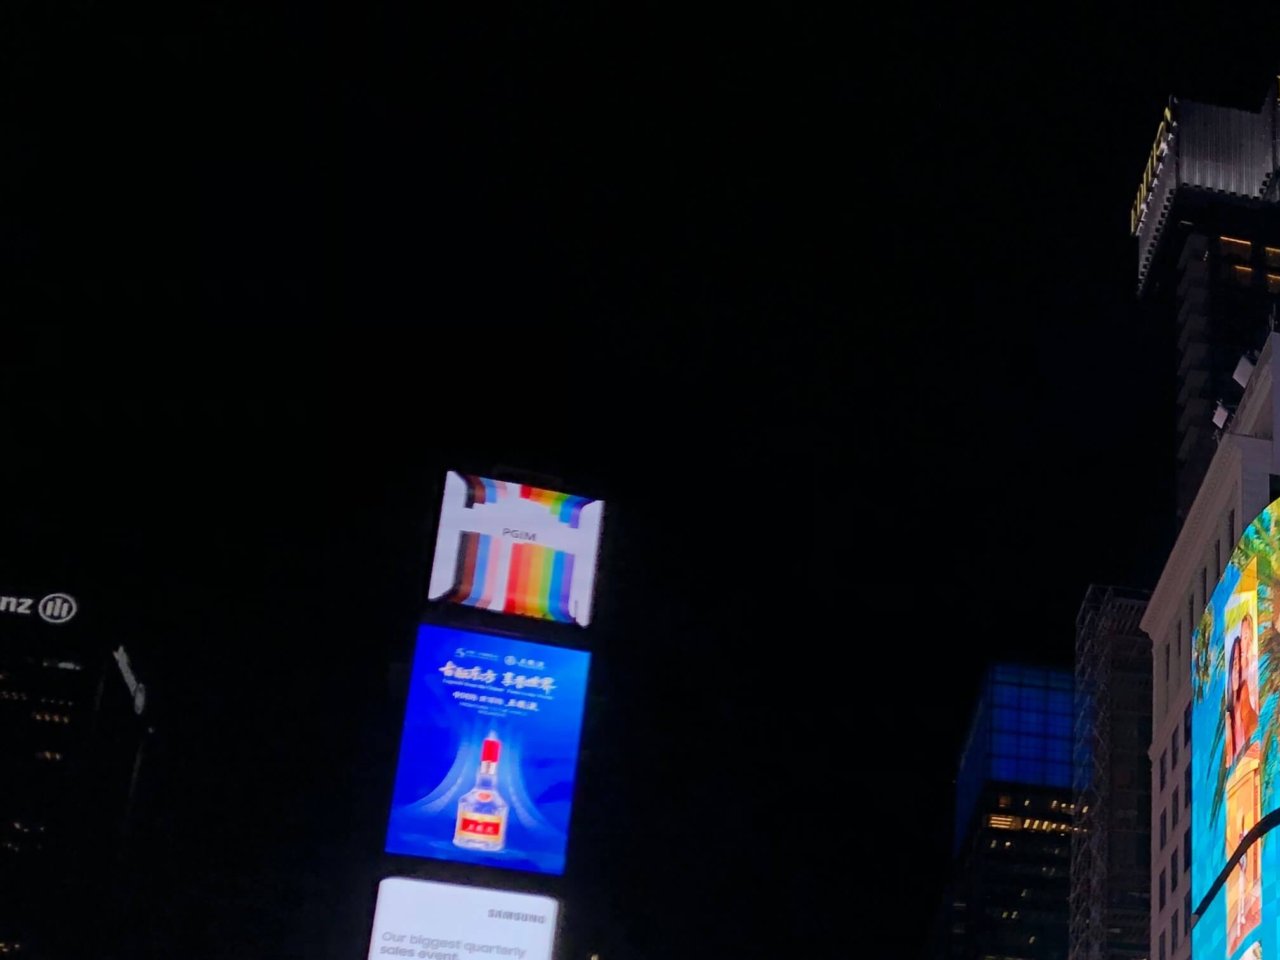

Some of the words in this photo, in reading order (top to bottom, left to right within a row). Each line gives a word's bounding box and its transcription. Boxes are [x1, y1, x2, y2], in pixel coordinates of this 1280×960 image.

[487, 909, 546, 924] SAMSUNG
[379, 945, 415, 957] sales
[381, 931, 407, 943] Our
[409, 934, 462, 950] biggest
[464, 941, 527, 960] quarterly
